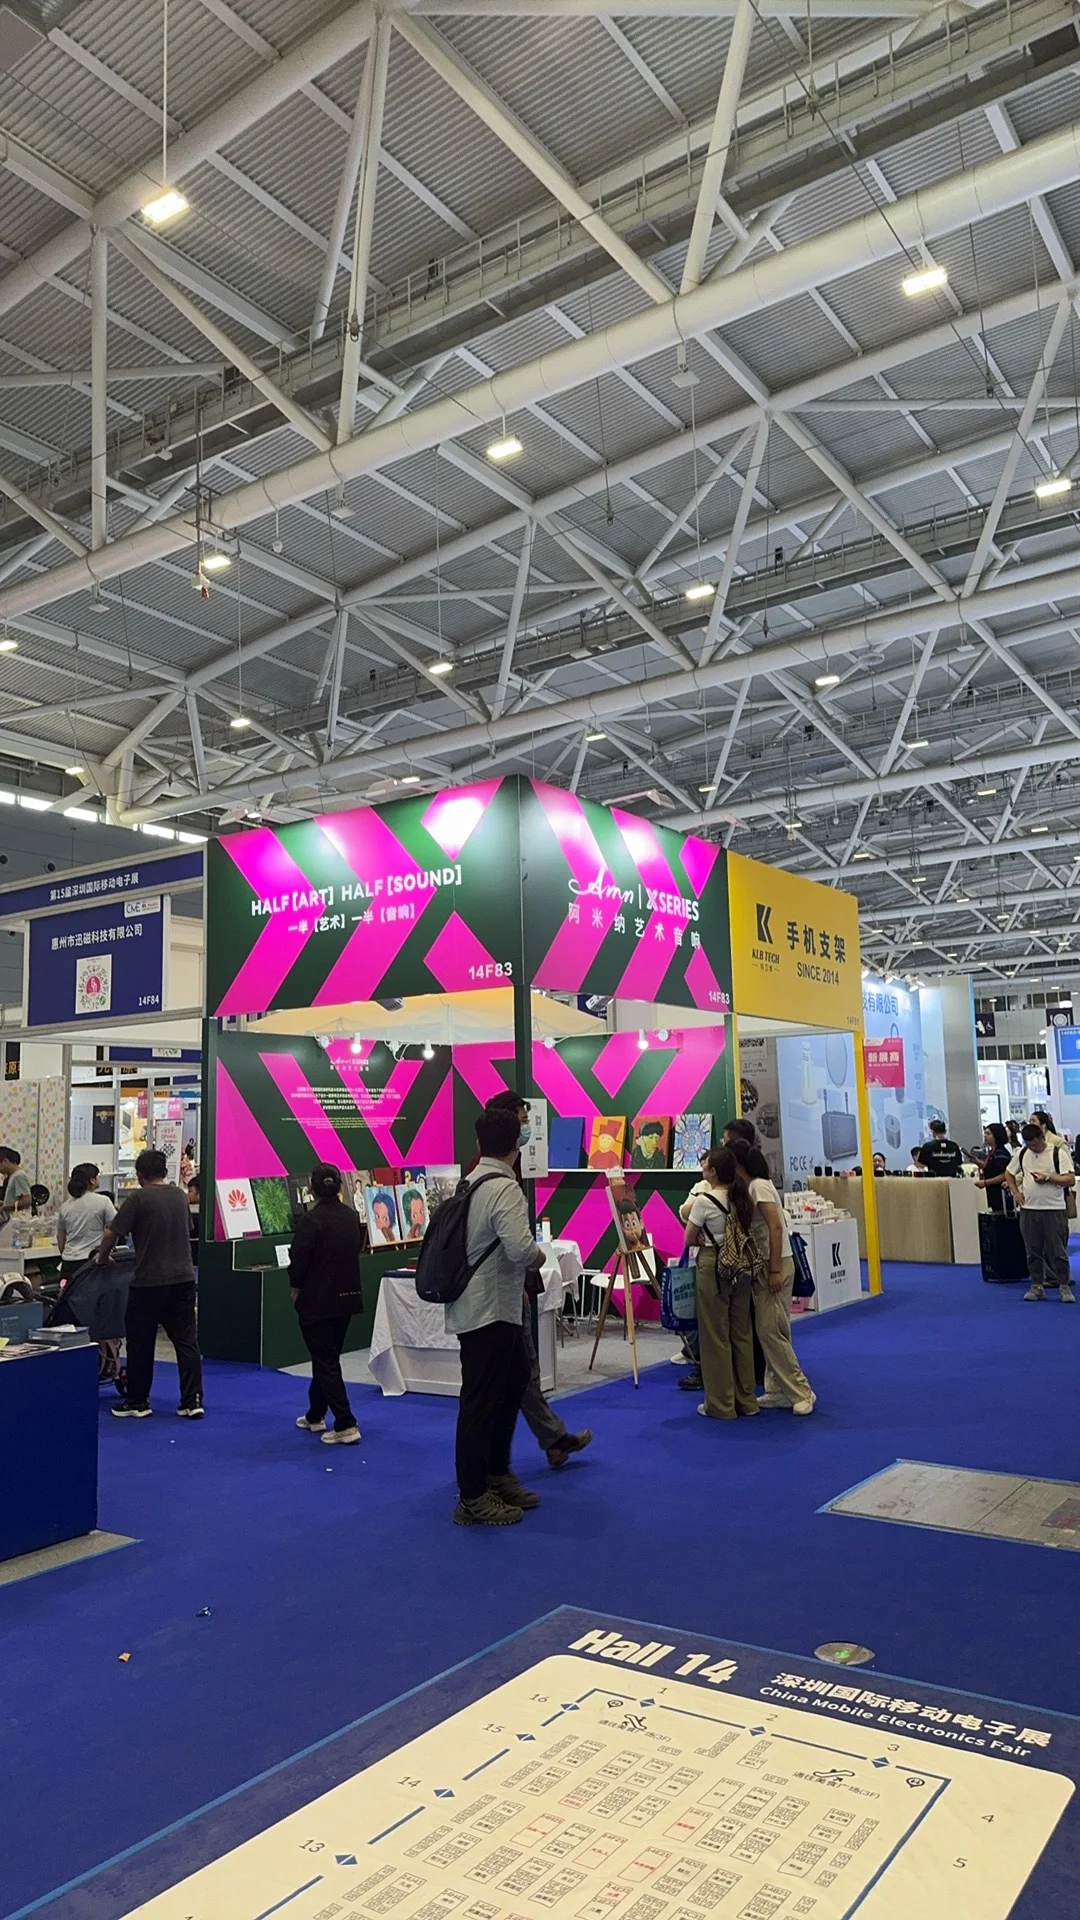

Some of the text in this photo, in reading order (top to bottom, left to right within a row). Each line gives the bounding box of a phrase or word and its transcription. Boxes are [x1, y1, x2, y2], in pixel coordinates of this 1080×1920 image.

[50, 872, 139, 901] 第15届深圳国际移动电子展
[786, 922, 846, 964] 手机支架
[468, 962, 513, 981] 14F83
[797, 961, 840, 986] SINCE 2014
[138, 994, 160, 1006] 14F84
[708, 990, 730, 1005] 14F83
[568, 1629, 738, 1684] Hall 14
[529, 1693, 550, 1704] 16
[770, 1672, 1052, 1748] 深圳国际移动电子展
[759, 1686, 1032, 1757] China Mobile Electronics Fair
[766, 1714, 778, 1722] 2
[483, 1723, 506, 1734] 15
[888, 1744, 900, 1752] 3
[398, 1776, 422, 1788] 14
[980, 1814, 996, 1824] 4
[298, 1838, 326, 1853] 13
[952, 1857, 968, 1869] 5
